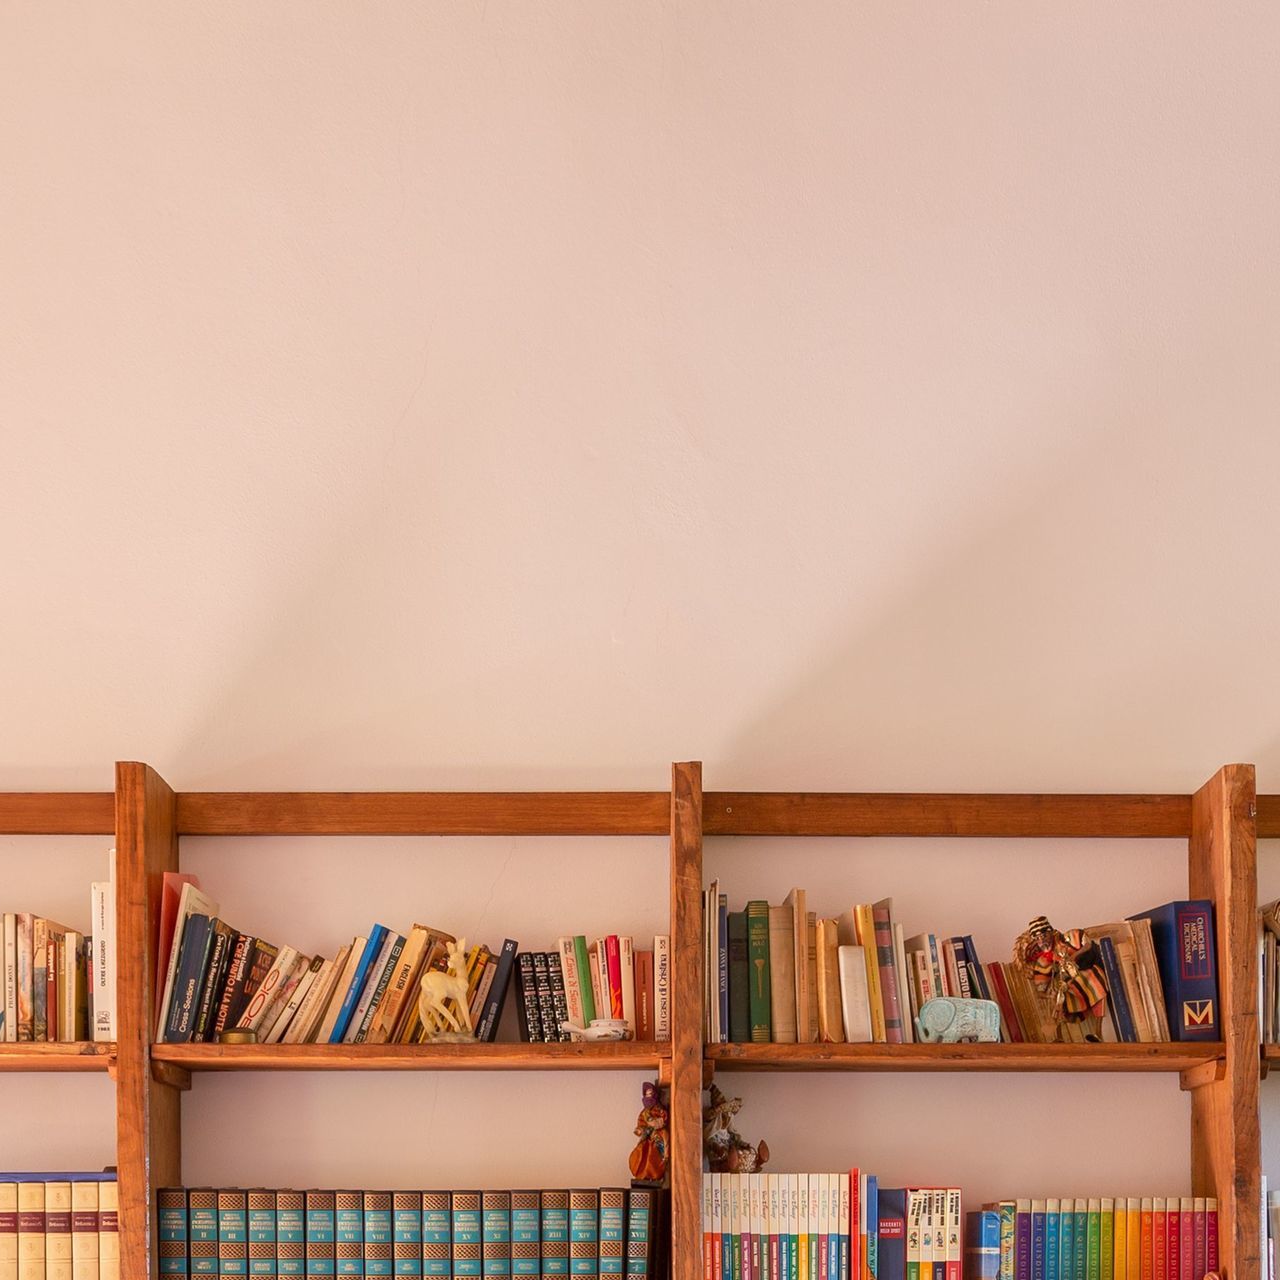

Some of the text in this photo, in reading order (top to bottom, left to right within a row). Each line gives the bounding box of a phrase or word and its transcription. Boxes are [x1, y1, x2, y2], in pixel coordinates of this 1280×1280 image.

[234, 942, 244, 958] CHE
[1183, 923, 1192, 964] DICTIONARY
[1190, 922, 1198, 952] MEDICAL
[1196, 916, 1206, 961] CHURCHILL'S
[227, 959, 240, 986] PUNTO
[376, 959, 397, 993] INCISIONI
[394, 963, 412, 991] ENGLISH
[957, 960, 966, 968] IL
[179, 979, 196, 1033] Cross-Sections
[222, 993, 231, 1003] LA
[371, 995, 382, 1005] LE
[657, 953, 668, 1032] La casa di Cristina
[215, 1004, 229, 1032] NOTTE
